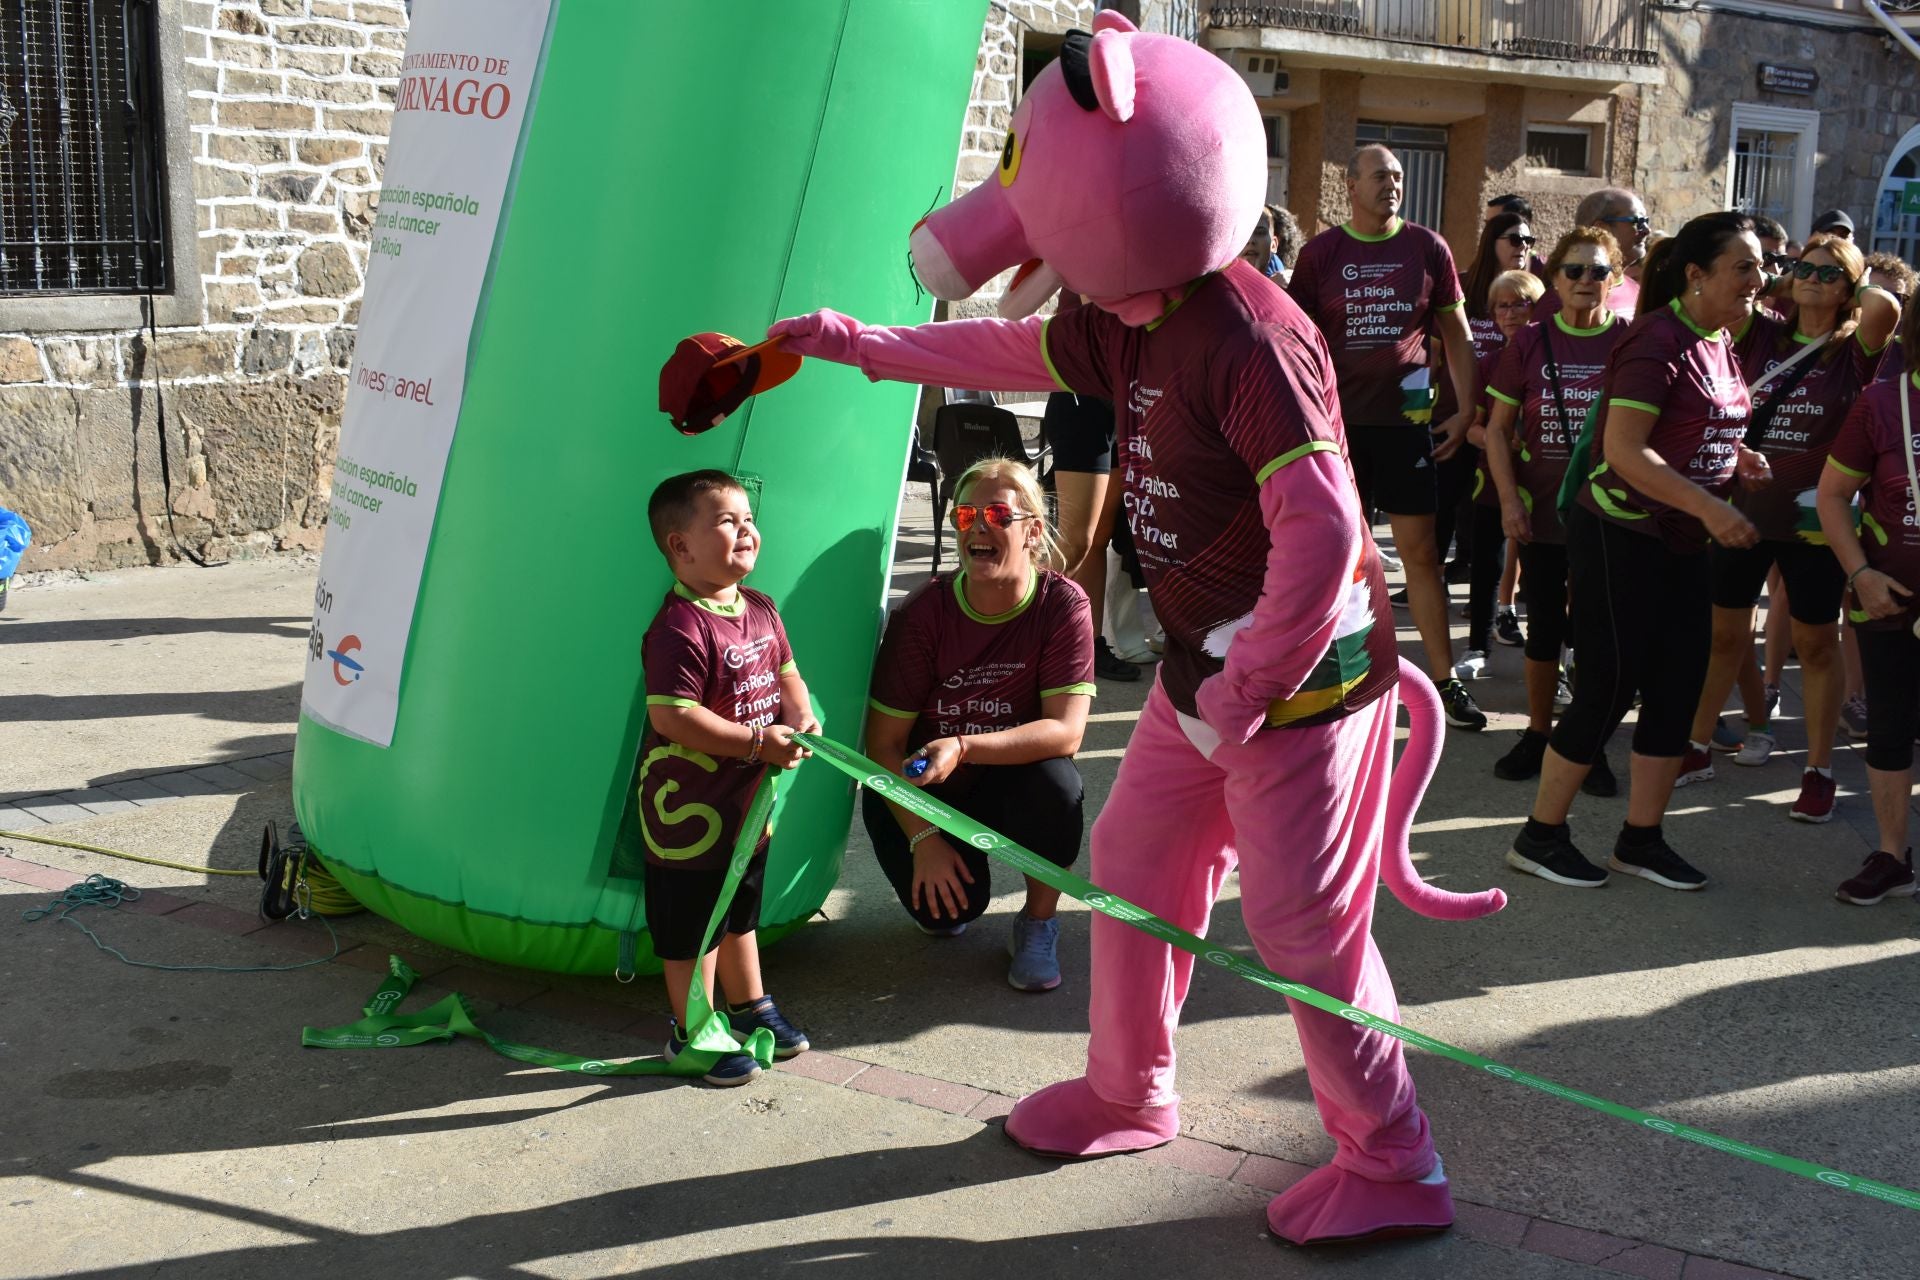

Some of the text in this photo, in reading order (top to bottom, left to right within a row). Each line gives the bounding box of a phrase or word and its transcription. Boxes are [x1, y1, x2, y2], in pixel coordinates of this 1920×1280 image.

[483, 57, 510, 76] DE
[412, 192, 480, 216] española
[388, 210, 399, 230] el
[399, 215, 441, 235] cancer
[381, 236, 402, 260] Rioja
[1345, 285, 1395, 299] La Rioja
[1346, 300, 1413, 314] En marcha
[1346, 313, 1386, 325] contra
[1346, 324, 1404, 337] el cáncer
[356, 361, 435, 406] invespanel
[1541, 431, 1554, 443] el
[1689, 455, 1704, 468] el
[360, 471, 418, 497] española
[347, 488, 383, 514] cancer
[733, 669, 775, 696] La Rioja
[735, 701, 752, 718] En
[937, 697, 1012, 718] La Rioja
